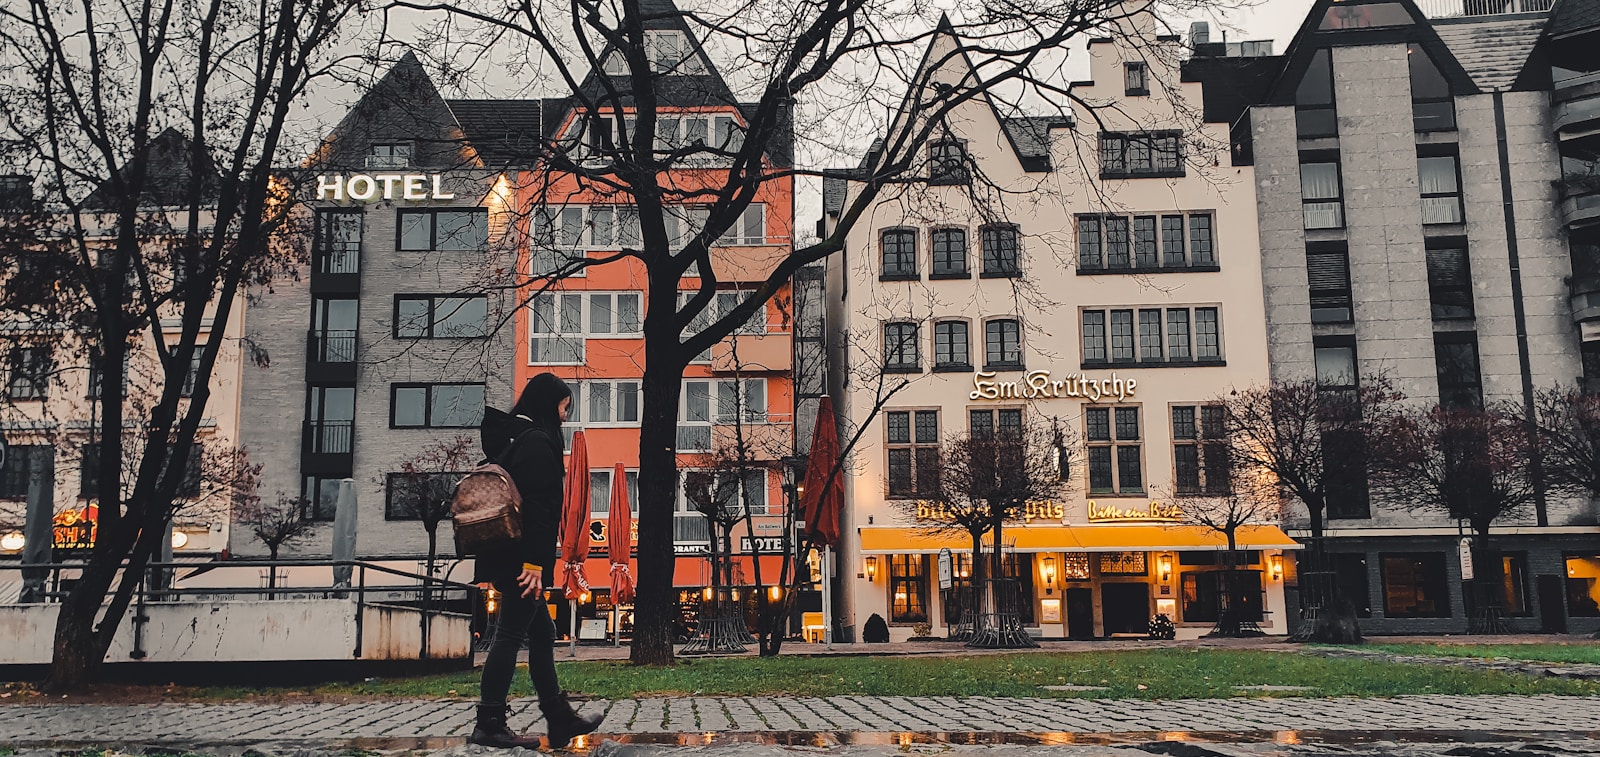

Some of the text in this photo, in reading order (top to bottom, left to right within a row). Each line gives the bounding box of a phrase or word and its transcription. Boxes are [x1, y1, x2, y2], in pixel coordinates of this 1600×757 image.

[316, 173, 455, 200] HOTEL
[1022, 369, 1138, 402] Krützche
[1024, 499, 1065, 524] Pils
[1088, 500, 1183, 519] Bitte ein Bit
[741, 538, 784, 550] HOTE
